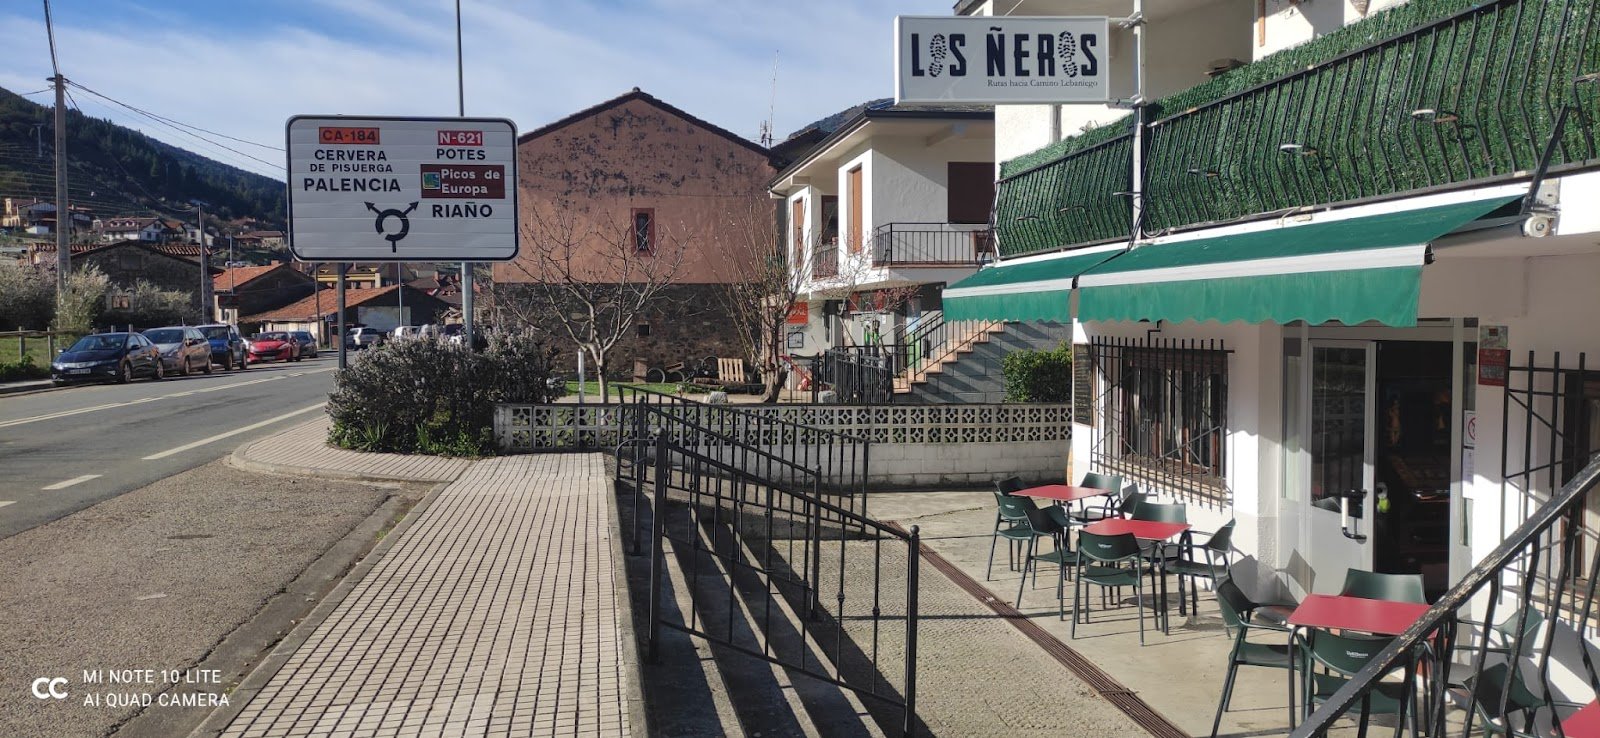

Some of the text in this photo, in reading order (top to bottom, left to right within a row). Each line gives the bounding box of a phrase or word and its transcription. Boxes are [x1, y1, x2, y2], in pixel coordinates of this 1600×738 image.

[987, 79, 1098, 89] Rutas hacia Camino Lebaniego
[322, 129, 376, 142] CA-184
[439, 132, 482, 144] N-621
[314, 149, 387, 161] CERVERA
[436, 148, 486, 160] POTES
[310, 164, 393, 173] DE PISUERGA
[441, 169, 500, 180] Picos de
[304, 178, 401, 192] PALENCIA
[441, 183, 488, 196] Europa
[432, 201, 493, 218] RIAÑO
